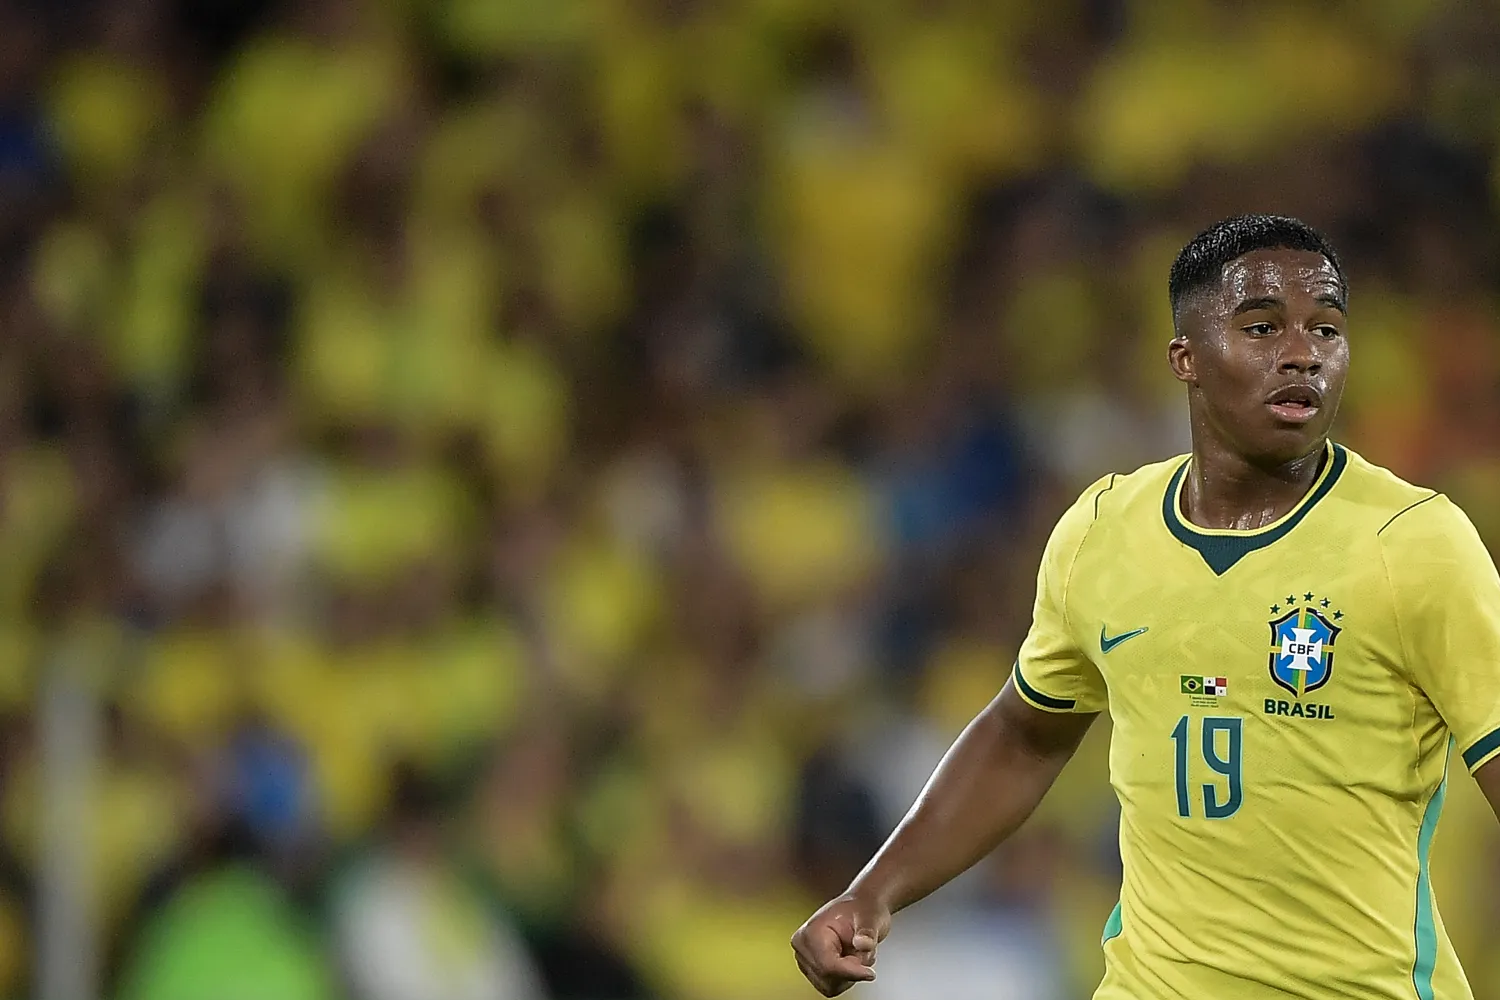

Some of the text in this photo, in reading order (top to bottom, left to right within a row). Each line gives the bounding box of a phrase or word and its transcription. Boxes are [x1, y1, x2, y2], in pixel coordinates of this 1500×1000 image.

[1288, 643, 1315, 655] CBF
[1264, 698, 1335, 719] BRASIL
[1170, 715, 1244, 820] 19
